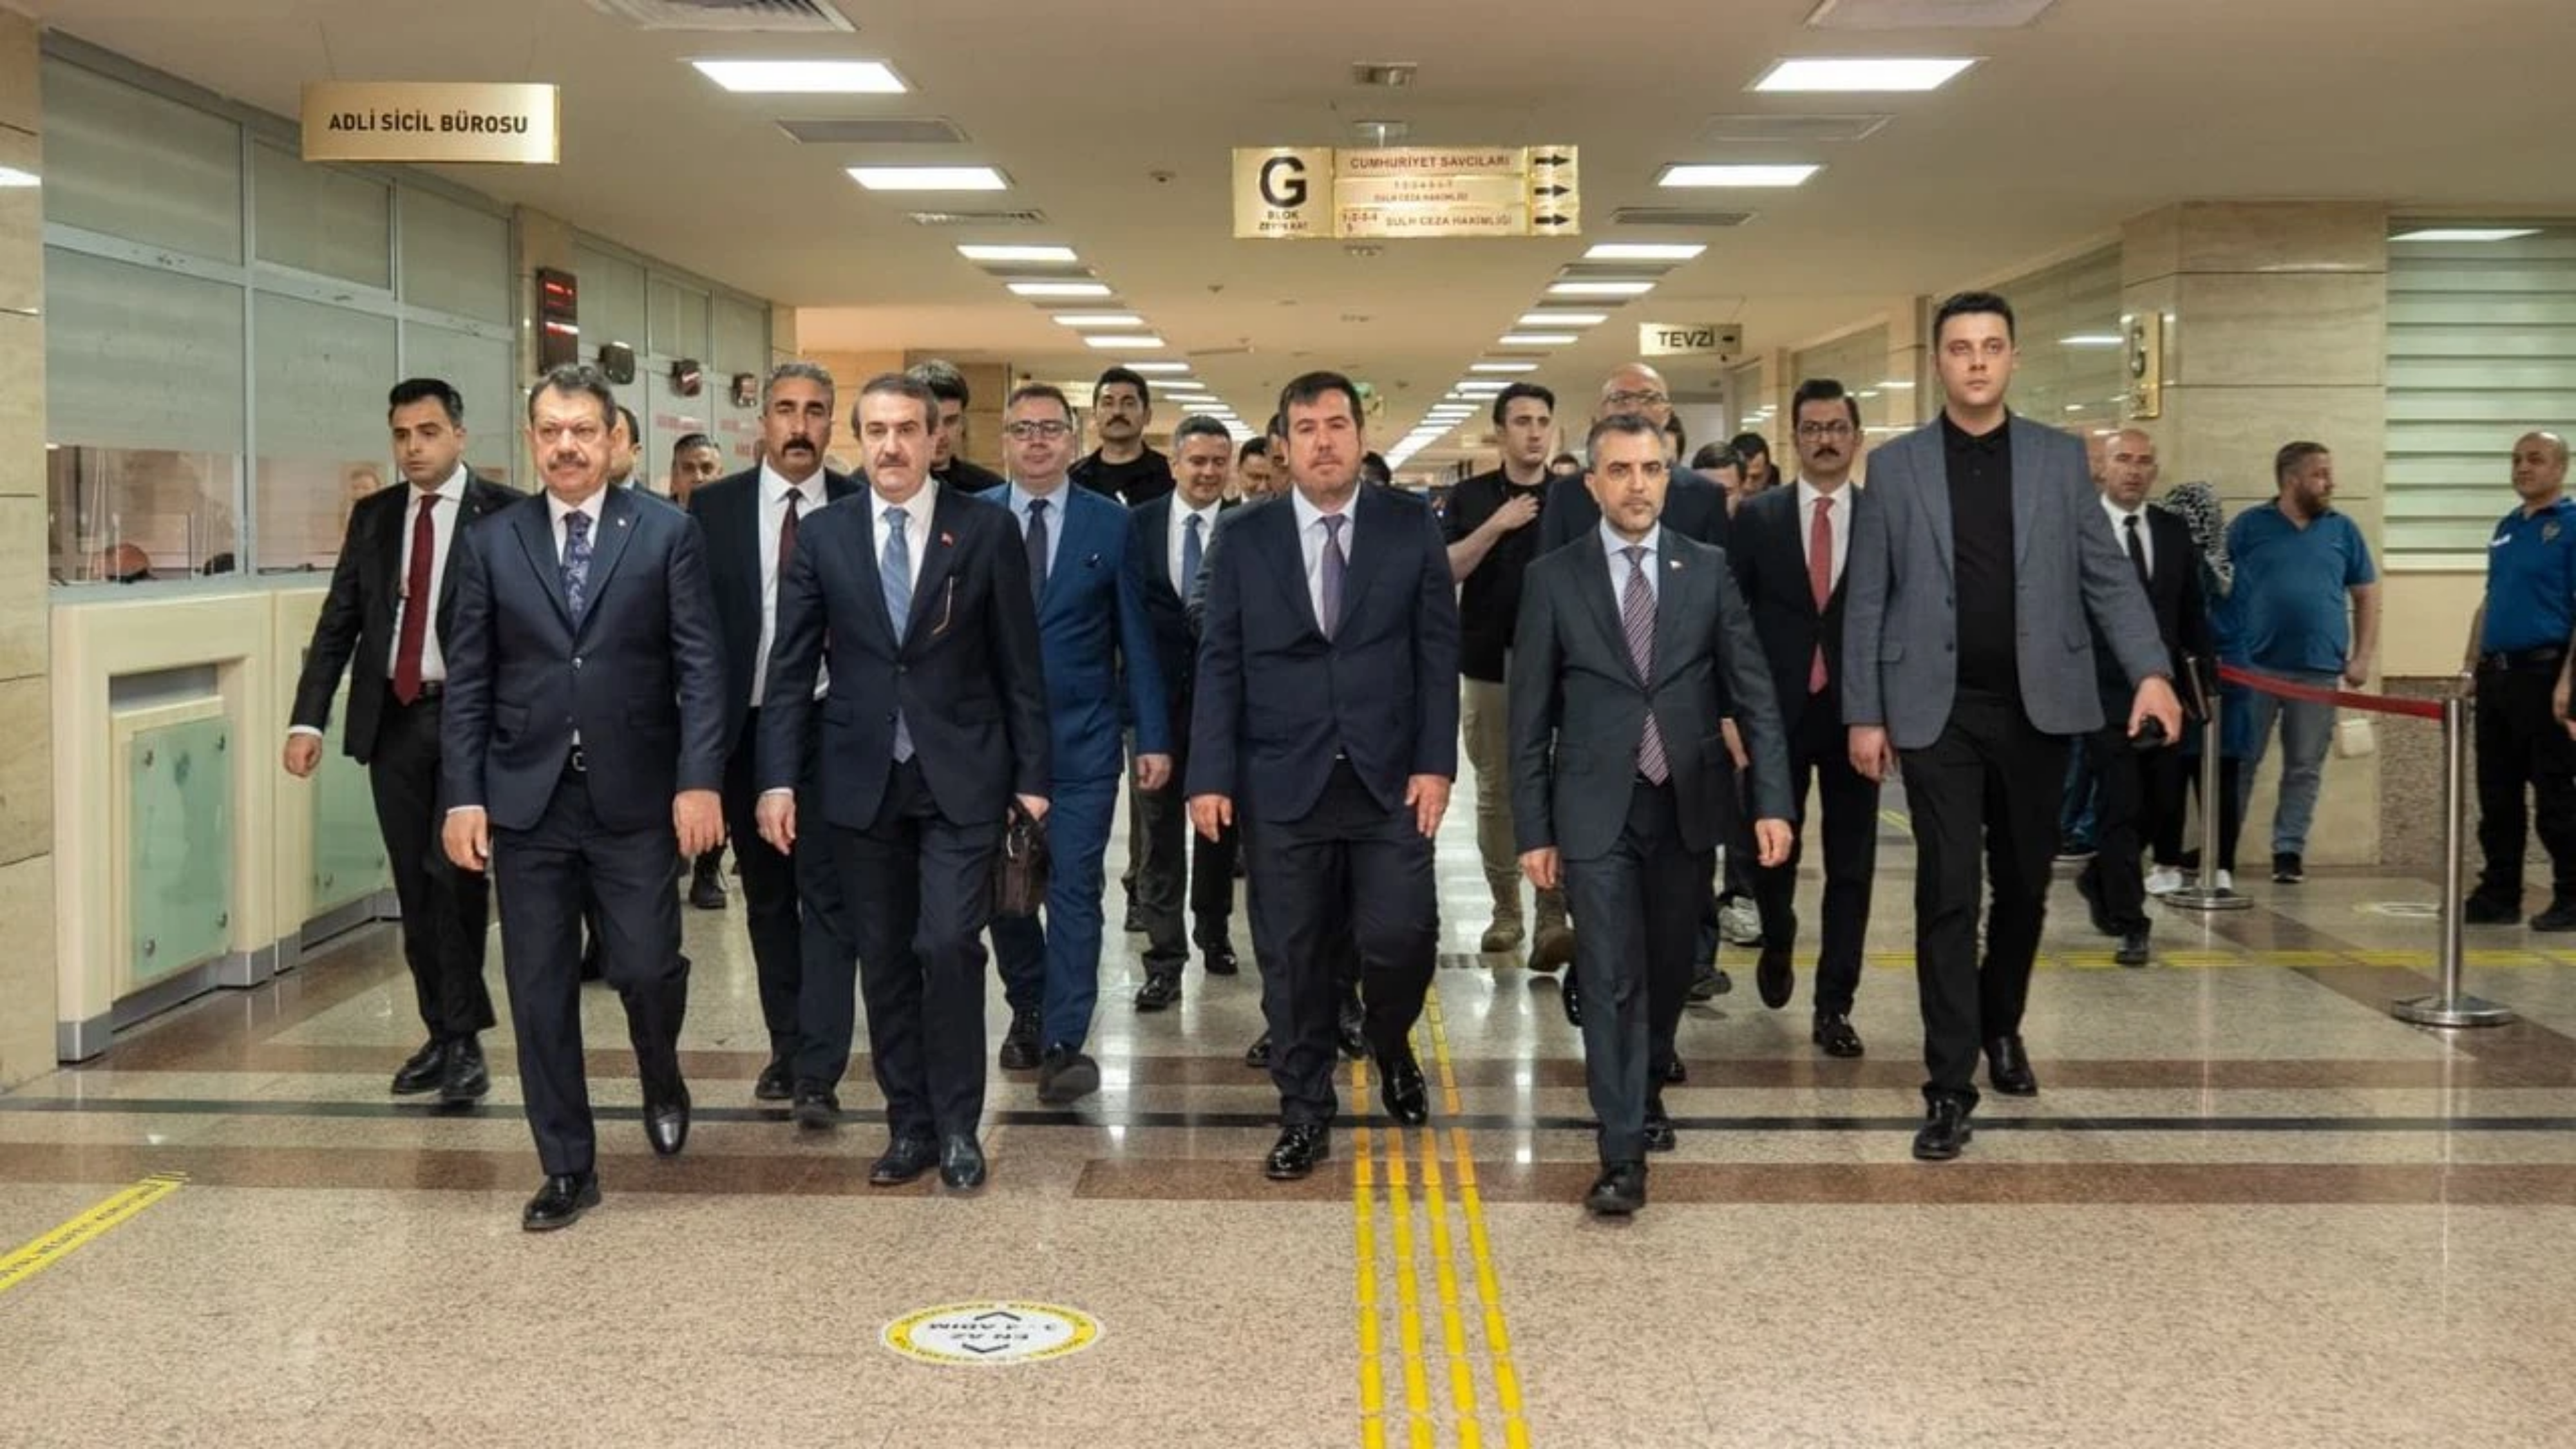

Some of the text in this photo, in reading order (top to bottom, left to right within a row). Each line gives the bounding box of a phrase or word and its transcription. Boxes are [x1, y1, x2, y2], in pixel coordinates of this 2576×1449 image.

[328, 108, 528, 134] ADLİ SİCİL BÜROSU
[1350, 156, 1510, 169] CUMHURİYET SAVCILARI
[1260, 156, 1307, 207] G
[1419, 216, 1449, 226] CEZA
